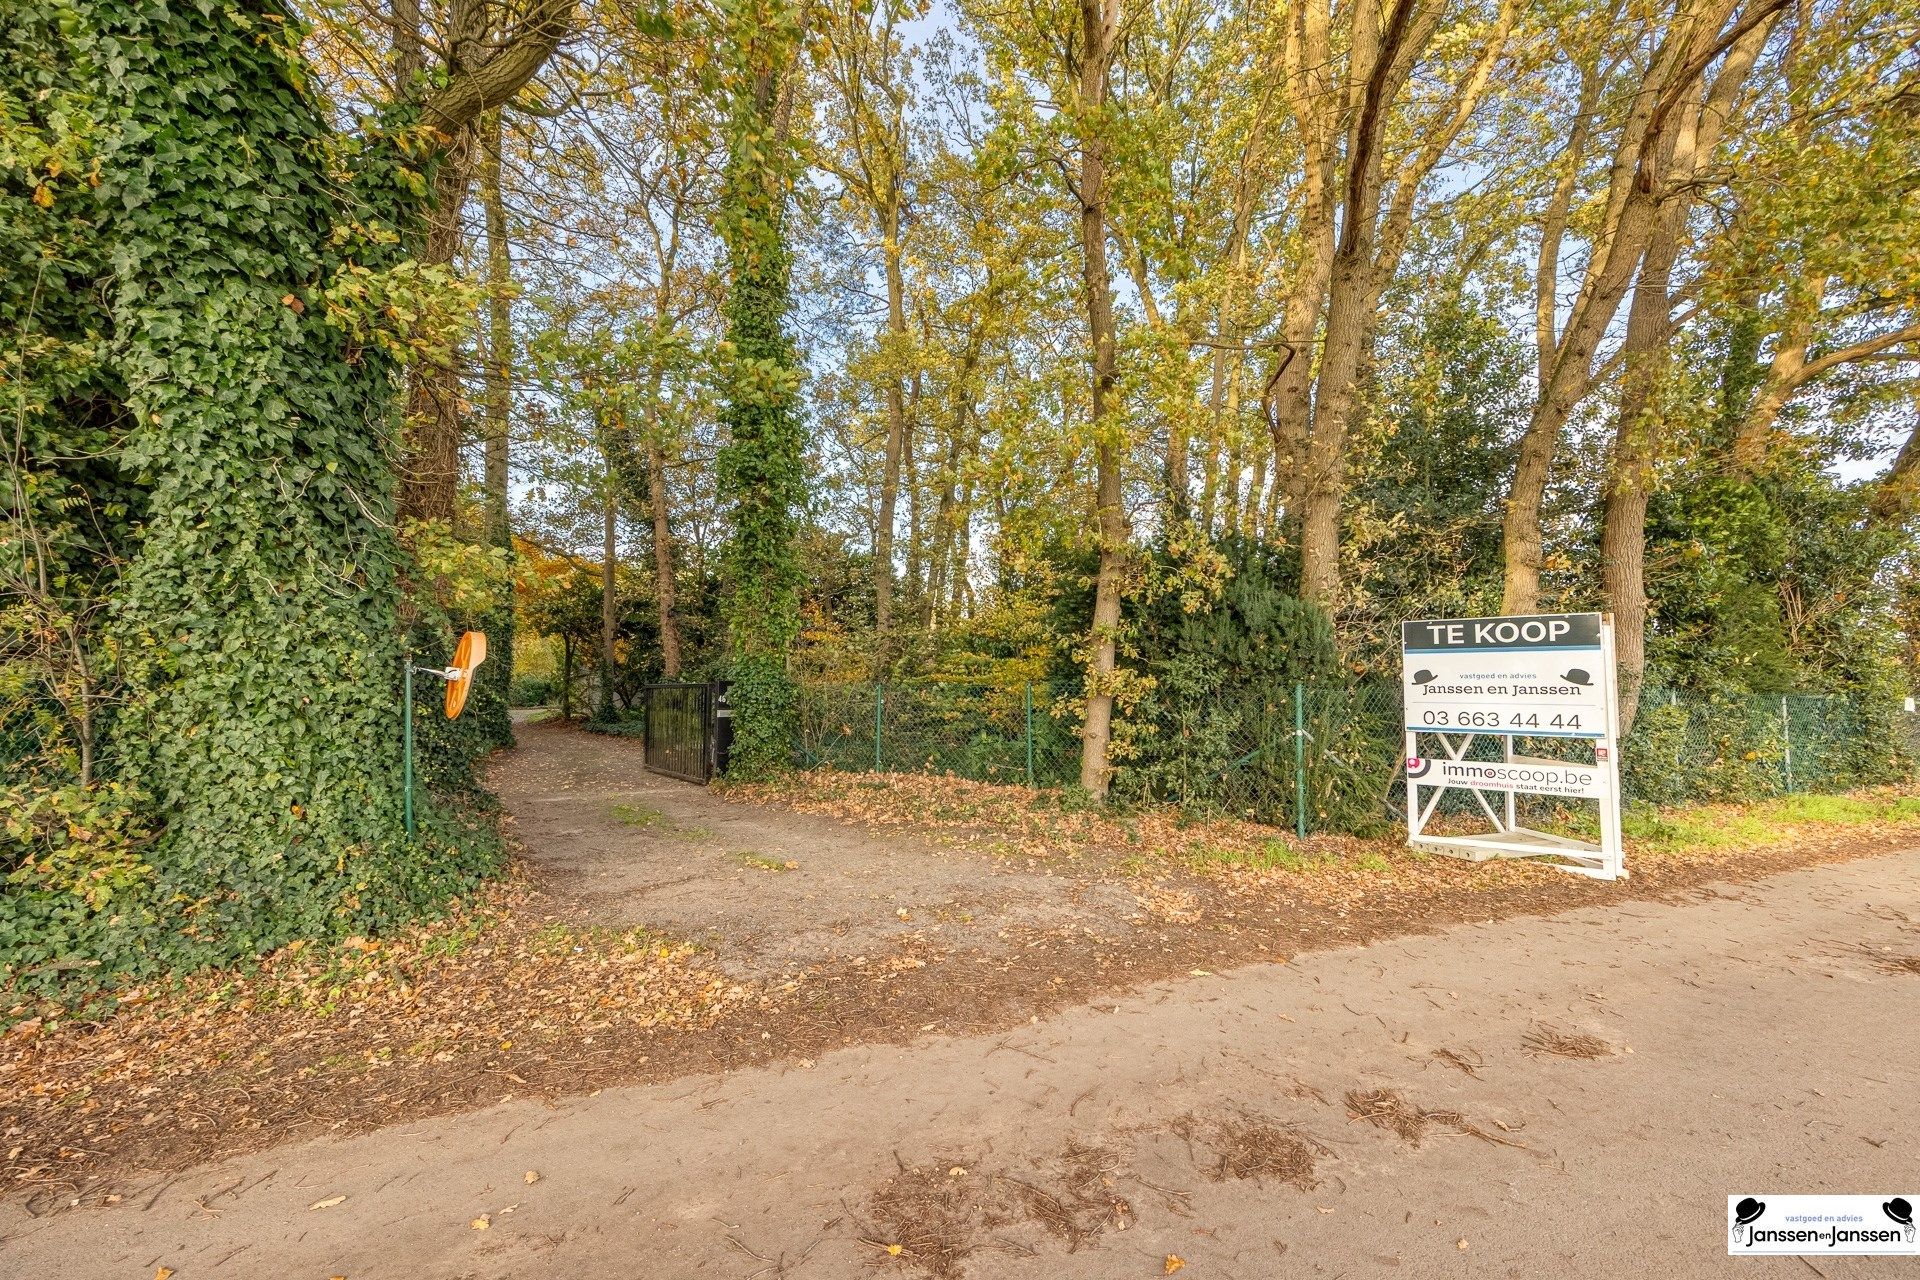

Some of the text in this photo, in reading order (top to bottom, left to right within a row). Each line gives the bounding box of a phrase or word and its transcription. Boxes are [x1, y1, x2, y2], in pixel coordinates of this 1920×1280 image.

[1426, 620, 1571, 645] TE KOOP
[1459, 672, 1496, 680] vastgoed
[1422, 684, 1582, 697] Janssen en Janssen
[1423, 710, 1582, 730] 03 663 44 44
[1442, 762, 1592, 786] immoscoop.be
[1470, 779, 1514, 789] droomhuis
[1515, 783, 1538, 791] staat
[1539, 785, 1562, 793] eerst
[1564, 785, 1584, 794] hier!
